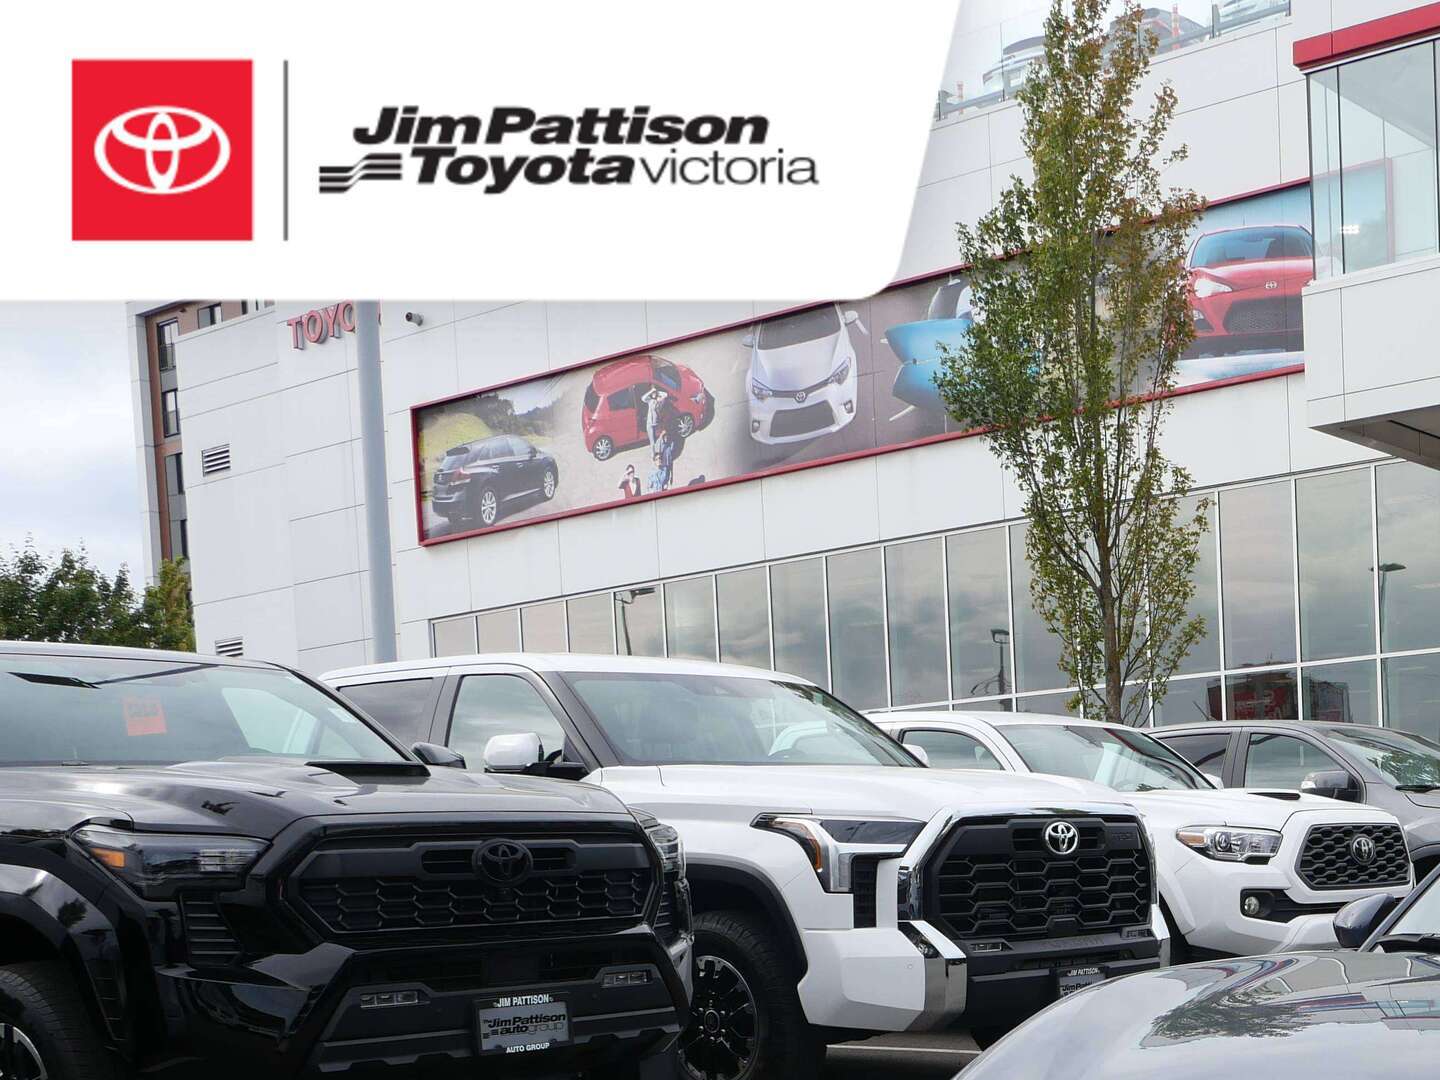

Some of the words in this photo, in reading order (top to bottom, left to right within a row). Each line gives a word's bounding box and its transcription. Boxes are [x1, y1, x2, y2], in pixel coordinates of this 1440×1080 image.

[287, 299, 382, 350] TOYO
[497, 997, 511, 1008] JIM
[512, 994, 549, 1007] PATTISON
[506, 1045, 525, 1054] AUTO
[526, 1042, 550, 1051] GROUP
